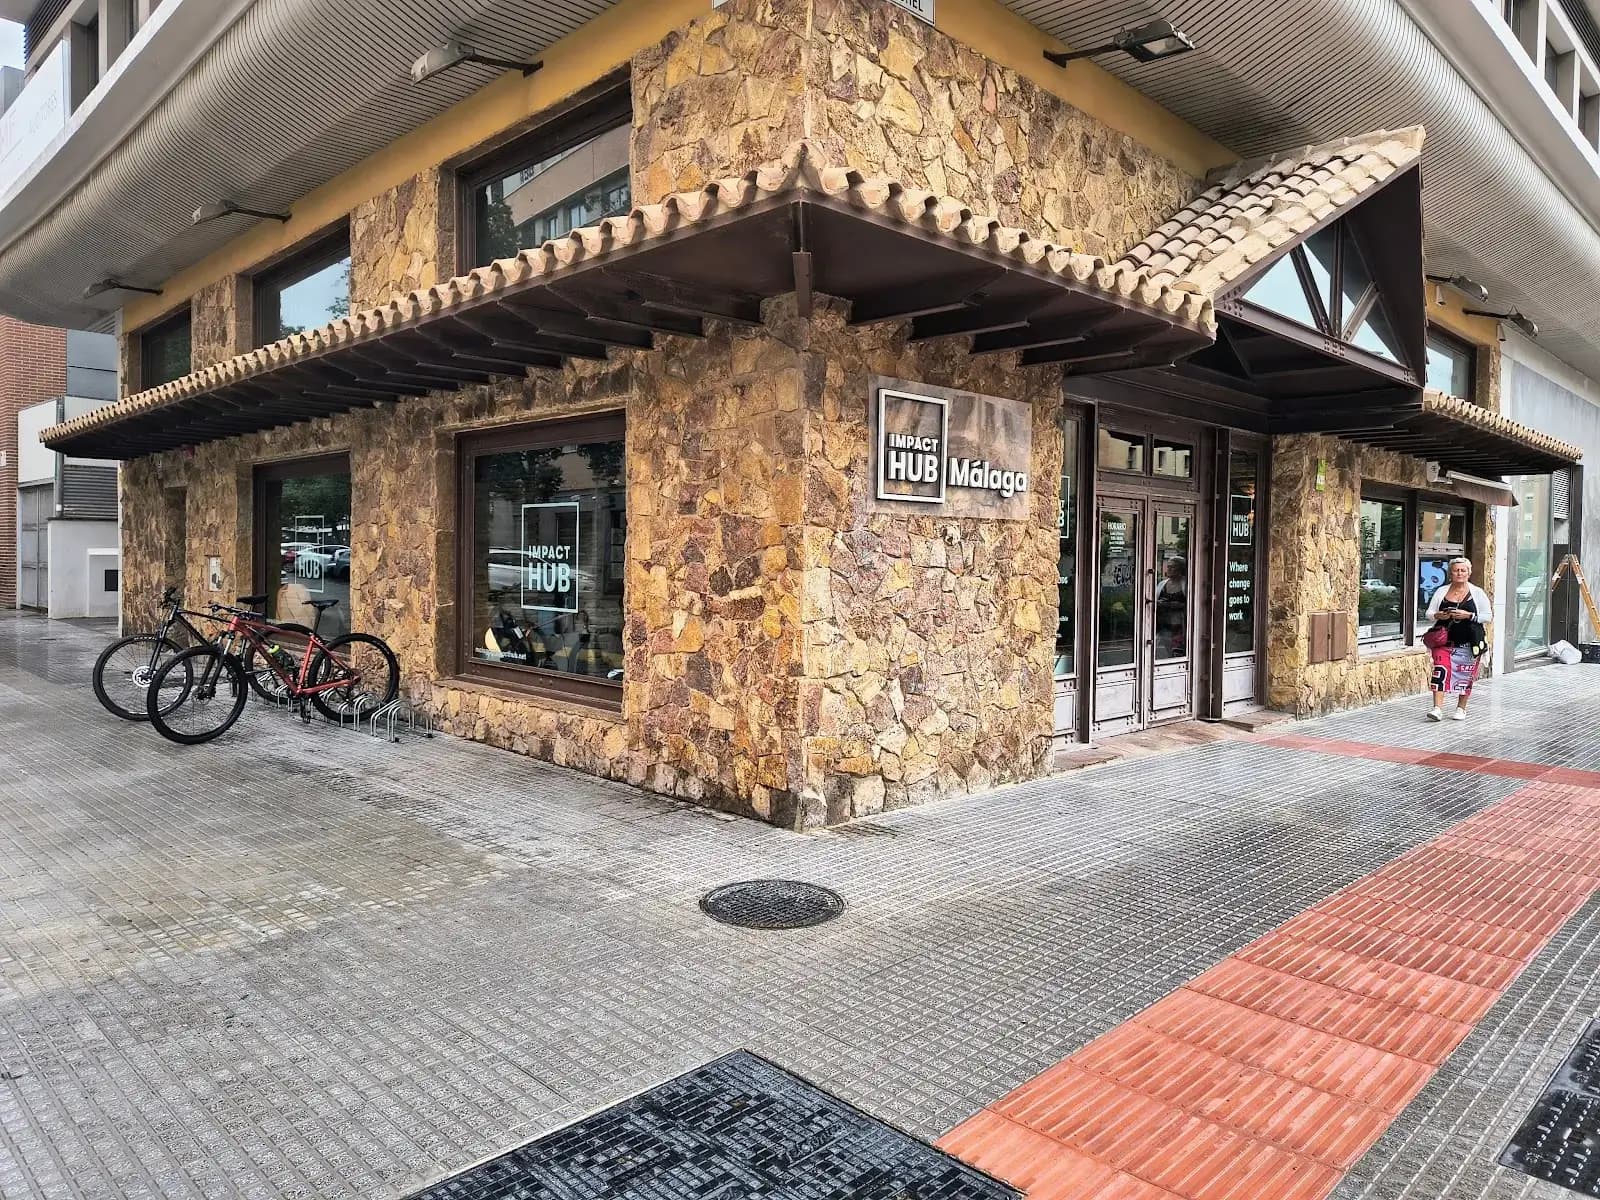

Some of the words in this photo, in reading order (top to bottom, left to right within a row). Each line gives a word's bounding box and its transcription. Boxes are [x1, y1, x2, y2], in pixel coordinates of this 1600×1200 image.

[888, 433, 938, 451] IMPACT
[887, 451, 938, 483] HUB
[949, 457, 1027, 497] Málaga
[1232, 522, 1249, 537] HUB
[528, 545, 570, 559] IMPACT
[298, 556, 320, 578] HUB
[1229, 561, 1248, 572] Where
[528, 562, 570, 593] HUB
[1229, 577, 1250, 590] change
[1229, 596, 1243, 607] goes
[1243, 594, 1250, 604] to
[1229, 609, 1243, 620] work
